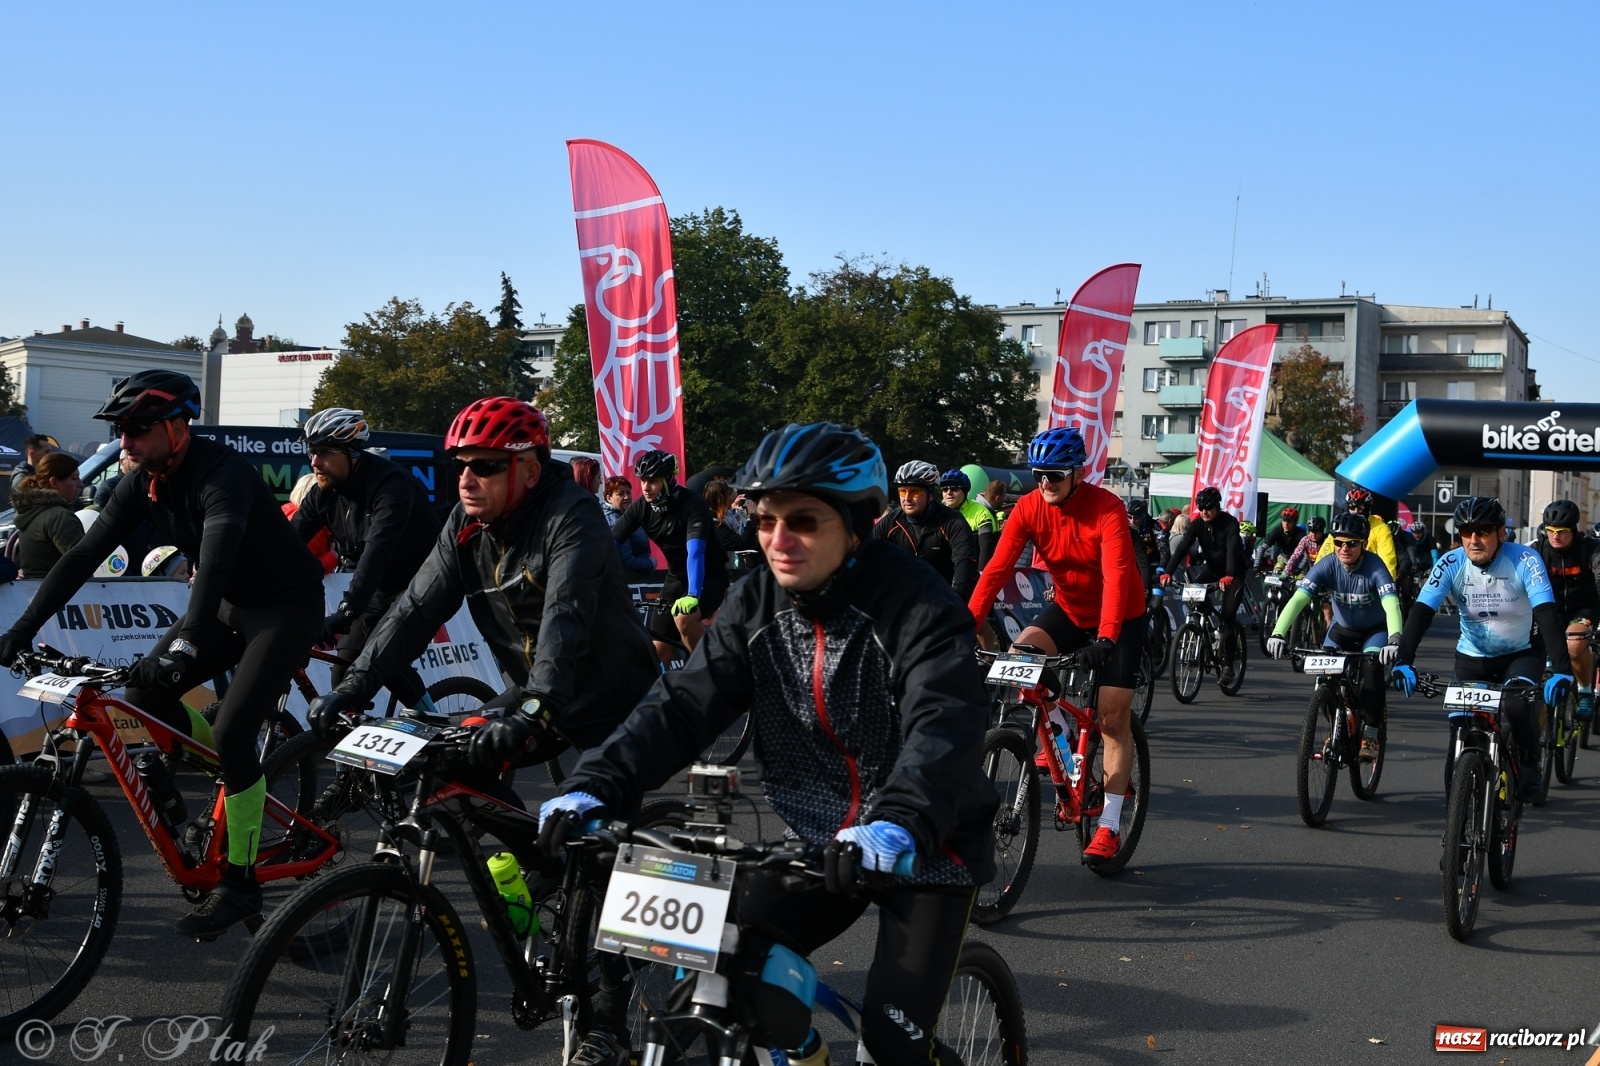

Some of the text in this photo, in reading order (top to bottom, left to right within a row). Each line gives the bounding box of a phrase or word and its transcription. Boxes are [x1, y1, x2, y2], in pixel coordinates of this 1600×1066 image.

[278, 354, 298, 362] BLACK
[298, 353, 312, 361] RED
[225, 434, 266, 454] bike
[1482, 423, 1541, 450] bike
[1429, 553, 1458, 588] SCHC
[1519, 550, 1543, 587] SCHC
[56, 604, 151, 630] TAURUS
[420, 642, 479, 670] FRIENDS
[1310, 658, 1338, 666] 2139
[998, 665, 1034, 679] 1132
[1455, 690, 1491, 702] 1410
[352, 732, 407, 757] 1311
[97, 887, 108, 913] SWISS
[620, 890, 704, 934] 2680
[437, 912, 469, 979] MAXXIS
